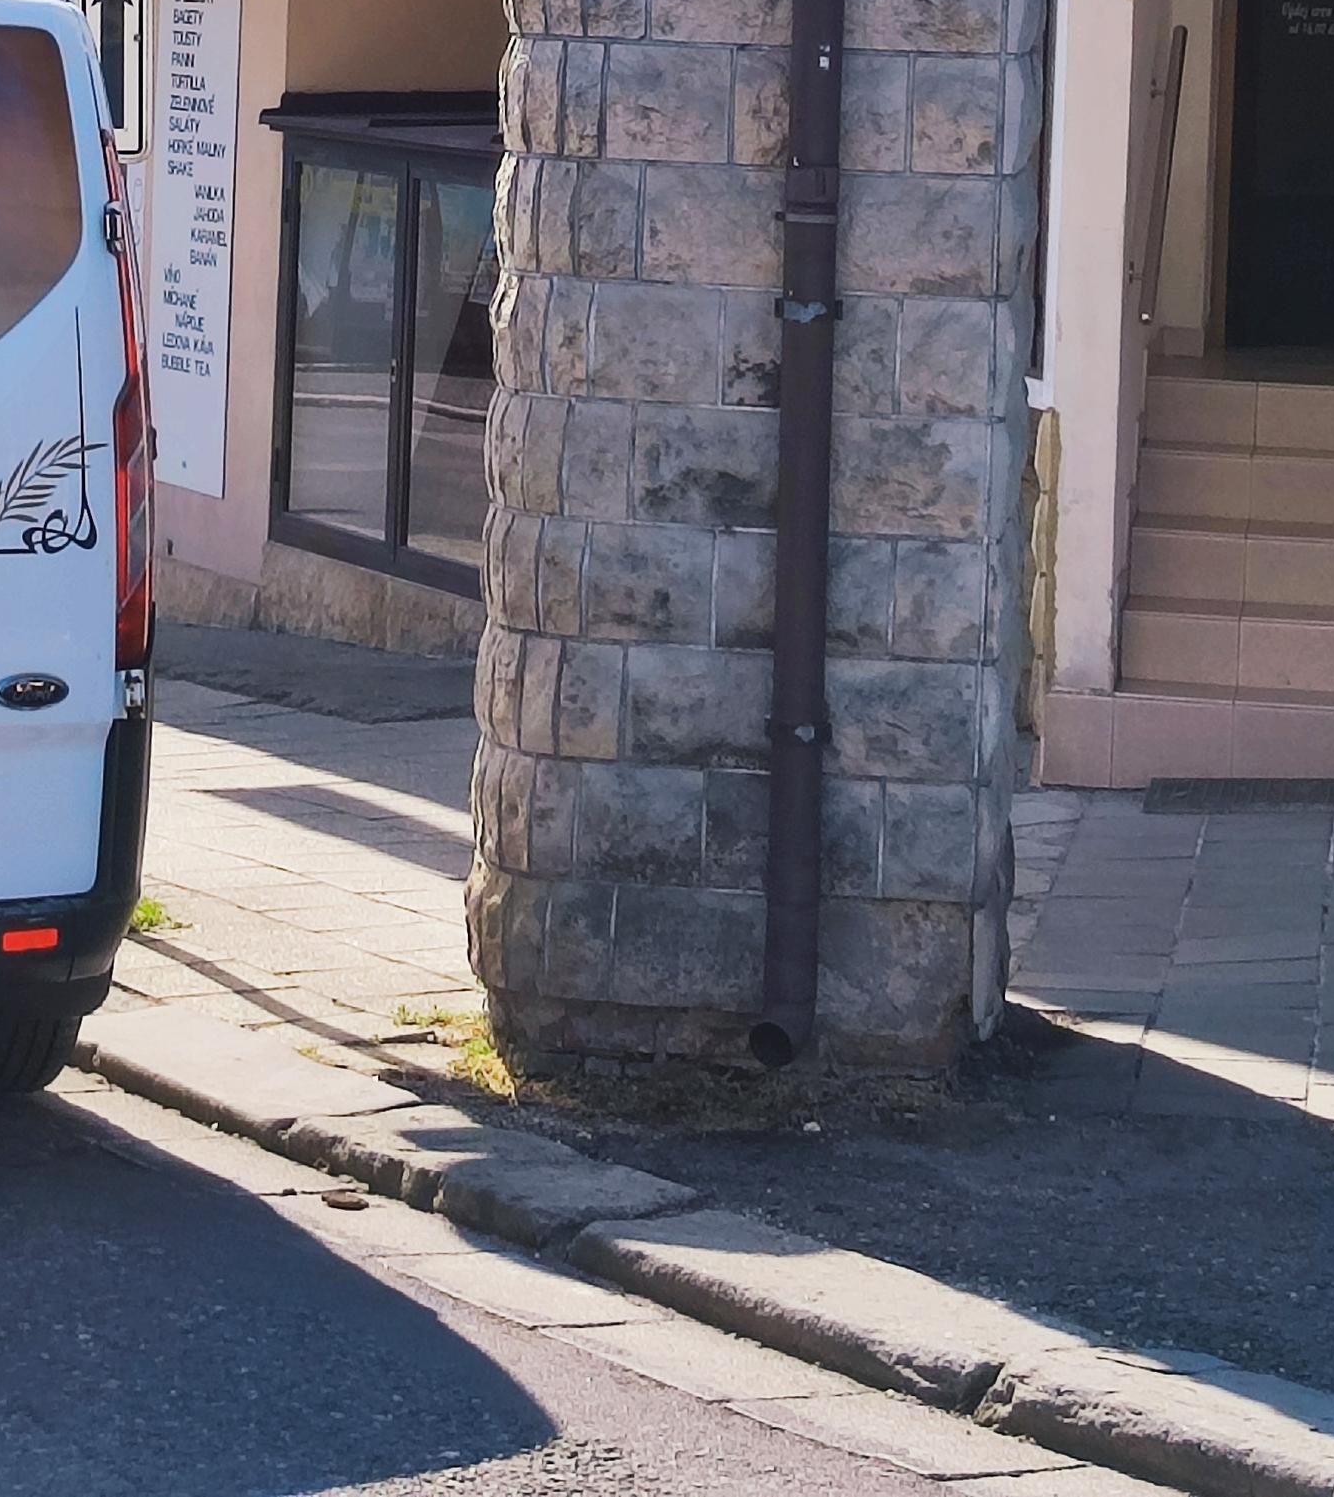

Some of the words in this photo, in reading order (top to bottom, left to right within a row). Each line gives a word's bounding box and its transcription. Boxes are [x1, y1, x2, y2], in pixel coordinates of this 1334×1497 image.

[171, 73, 207, 92] TORTILLA
[169, 114, 201, 134] SALÁTY
[167, 160, 194, 178] SHAKE
[193, 207, 225, 224] JAHODA
[190, 227, 228, 248] KARAMEL
[175, 311, 205, 333] NÁPOJE
[194, 359, 211, 378] TEA
